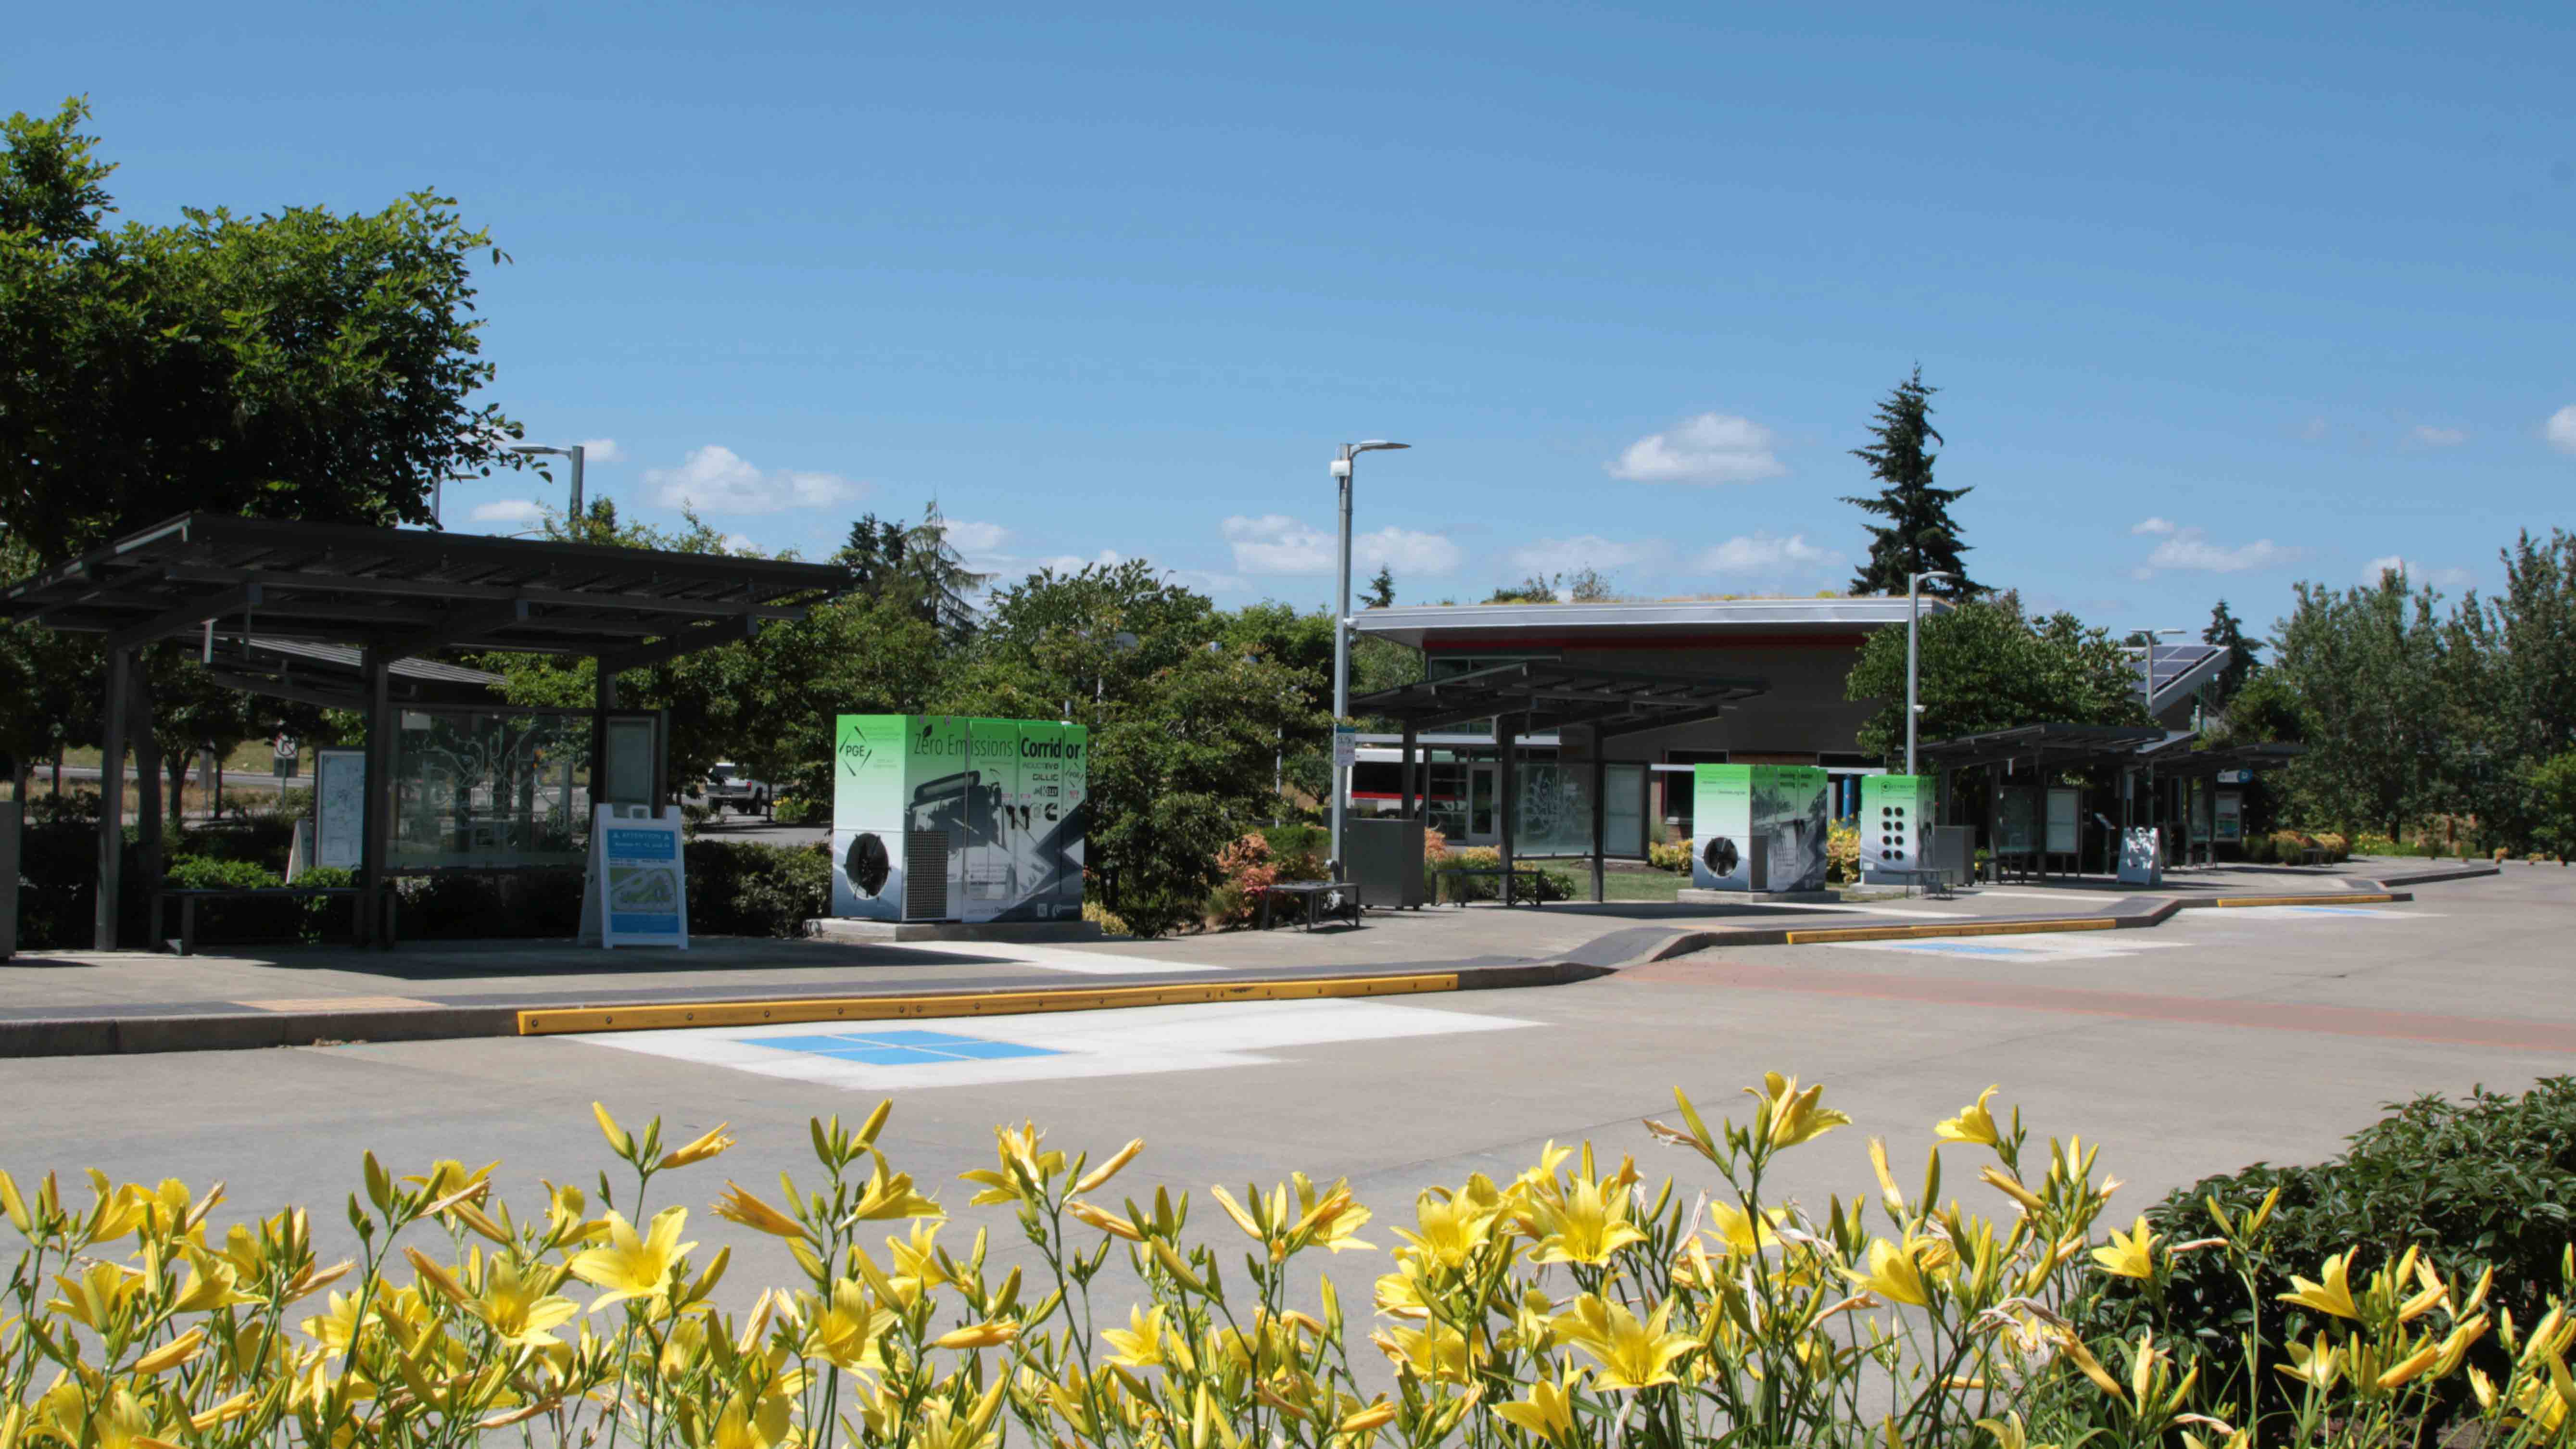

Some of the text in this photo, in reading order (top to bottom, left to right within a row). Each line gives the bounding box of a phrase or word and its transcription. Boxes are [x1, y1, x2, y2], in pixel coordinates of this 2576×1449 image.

[846, 745, 865, 757] PGE
[914, 733, 943, 755] Zero
[948, 734, 1013, 756] Emissions
